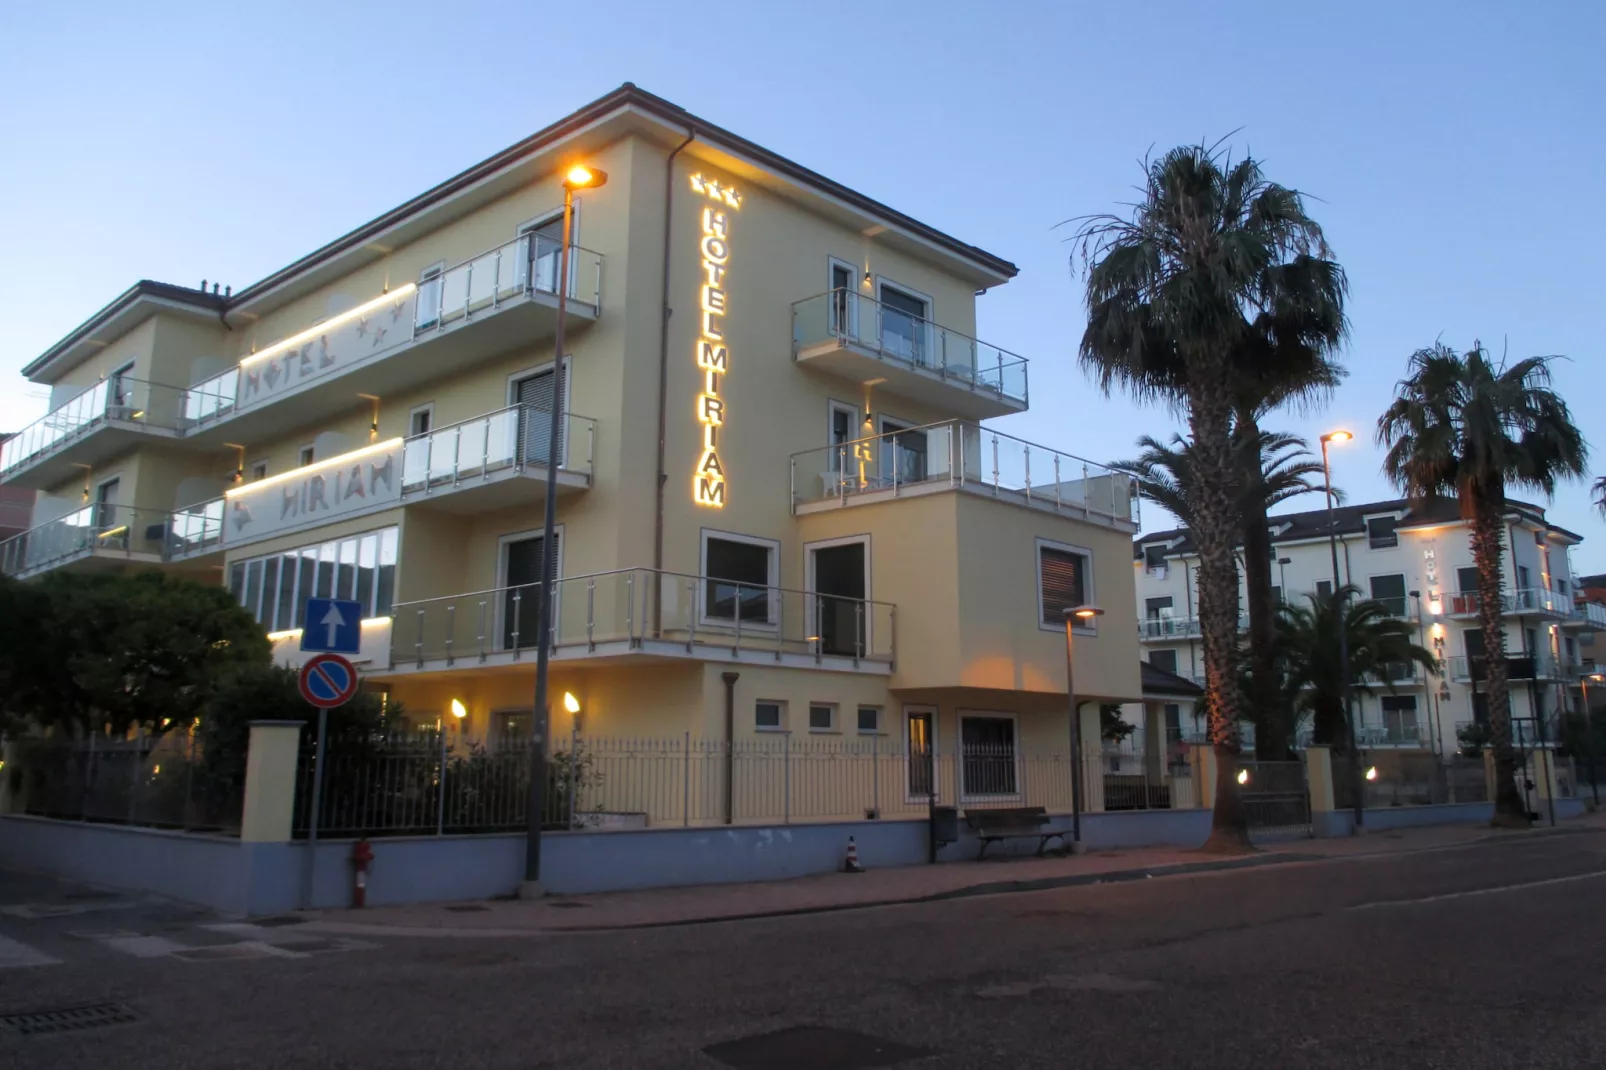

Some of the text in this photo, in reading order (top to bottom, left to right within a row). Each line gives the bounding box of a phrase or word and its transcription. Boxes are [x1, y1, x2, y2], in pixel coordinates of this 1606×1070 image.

[702, 207, 728, 340] HOTEL
[244, 334, 336, 401] HOTEL
[693, 340, 727, 508] MIRIAM
